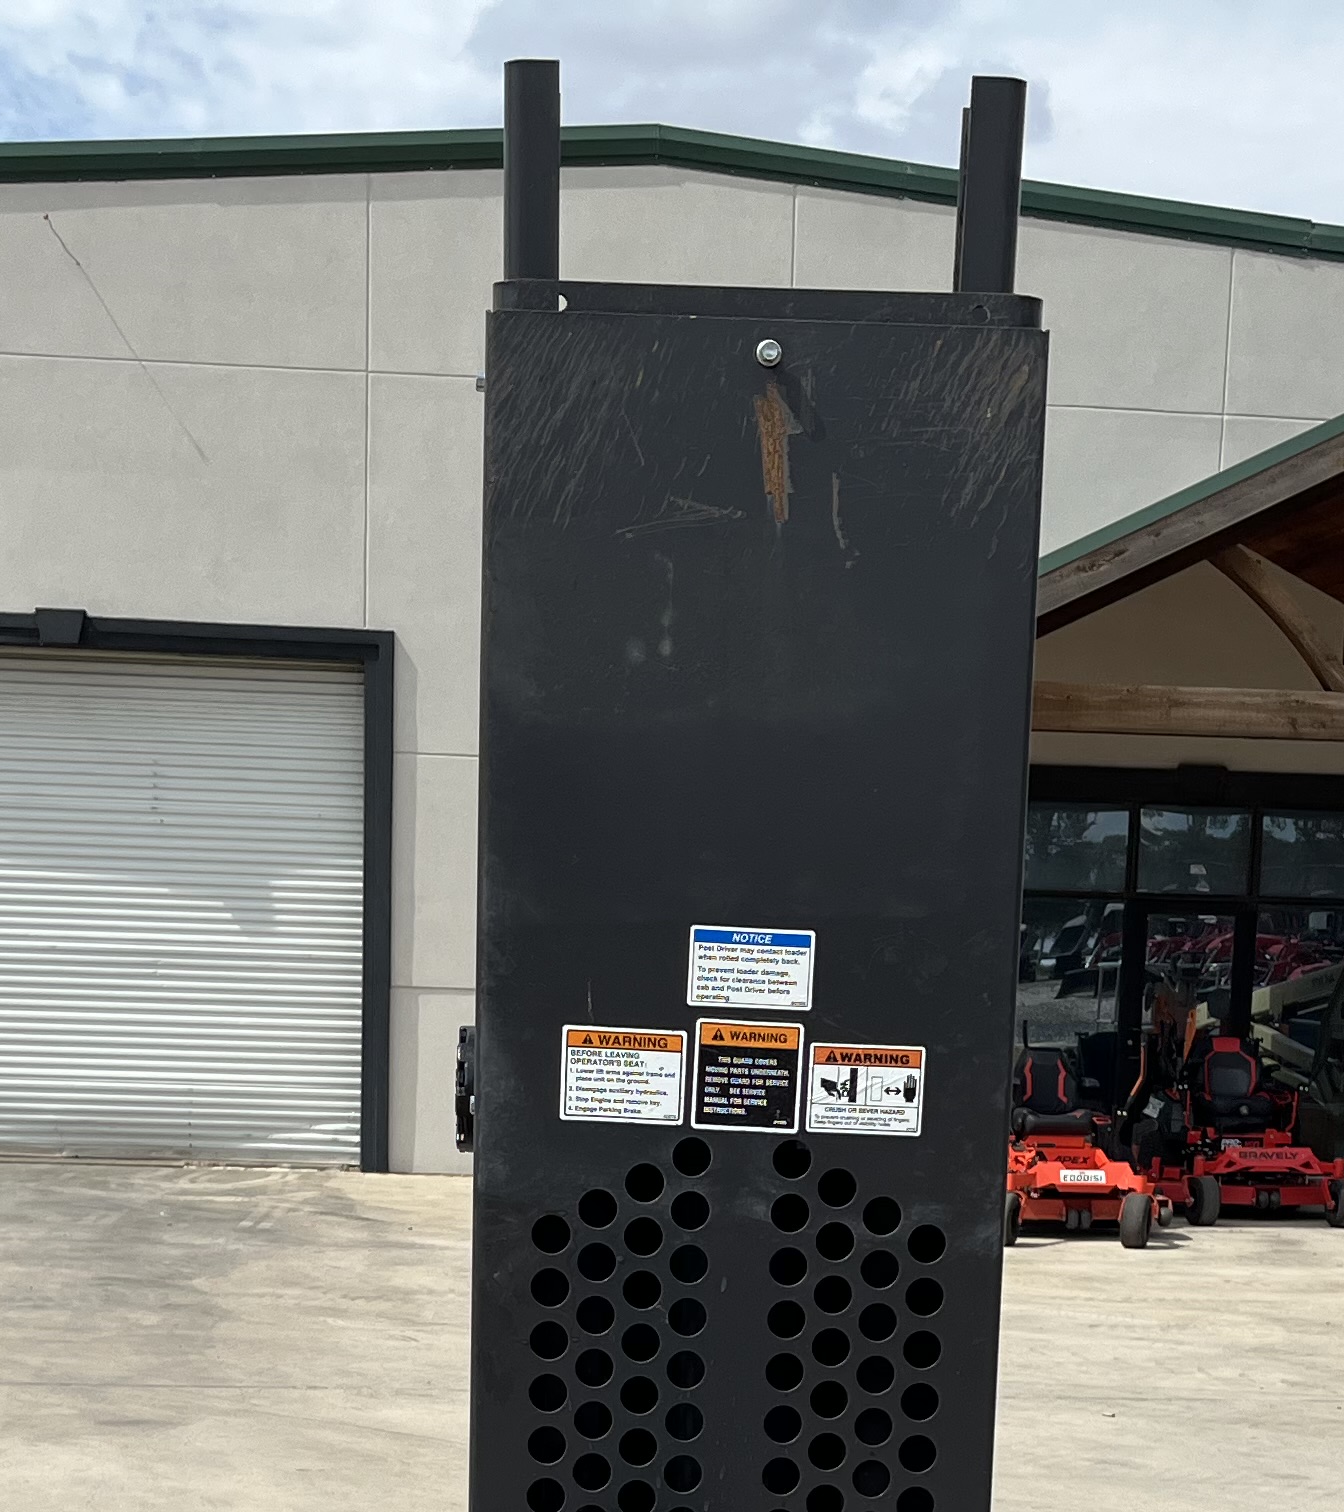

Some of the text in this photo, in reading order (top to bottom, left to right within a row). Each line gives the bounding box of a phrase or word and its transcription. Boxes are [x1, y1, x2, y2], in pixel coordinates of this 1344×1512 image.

[732, 932, 773, 944] NOTICE
[597, 1034, 669, 1049] WARNING
[729, 1030, 789, 1044] WARNING
[570, 1049, 640, 1060] BEFORE LEAVING
[839, 1051, 910, 1065] WARNING
